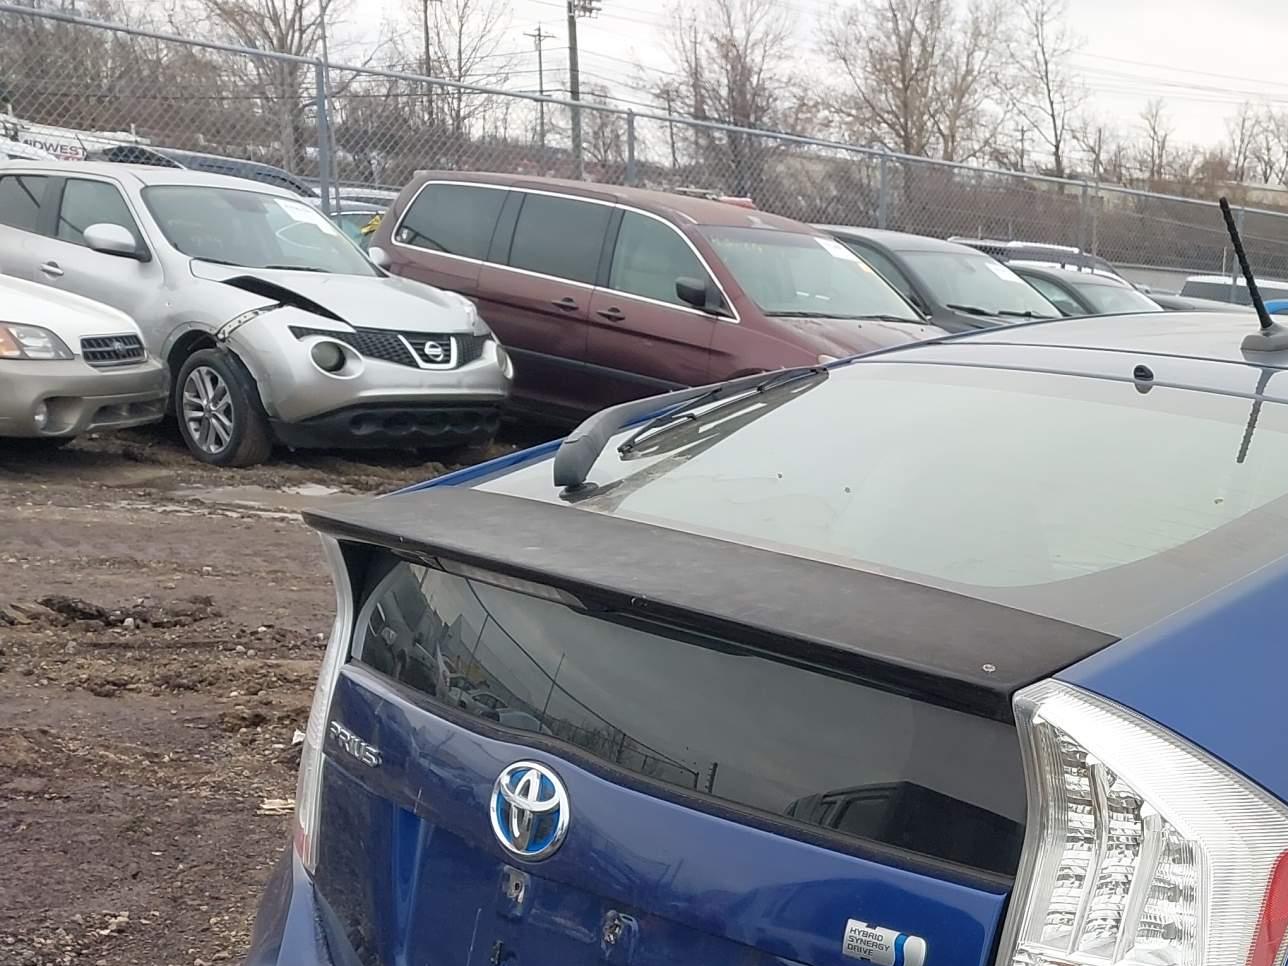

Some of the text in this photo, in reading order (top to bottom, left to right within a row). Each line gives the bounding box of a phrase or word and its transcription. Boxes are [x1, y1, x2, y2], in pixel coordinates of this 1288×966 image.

[330, 720, 379, 767] PRIUS
[849, 927, 884, 942] HYBRID
[847, 935, 890, 952] SYNERGY
[847, 943, 874, 956] DRIVE
